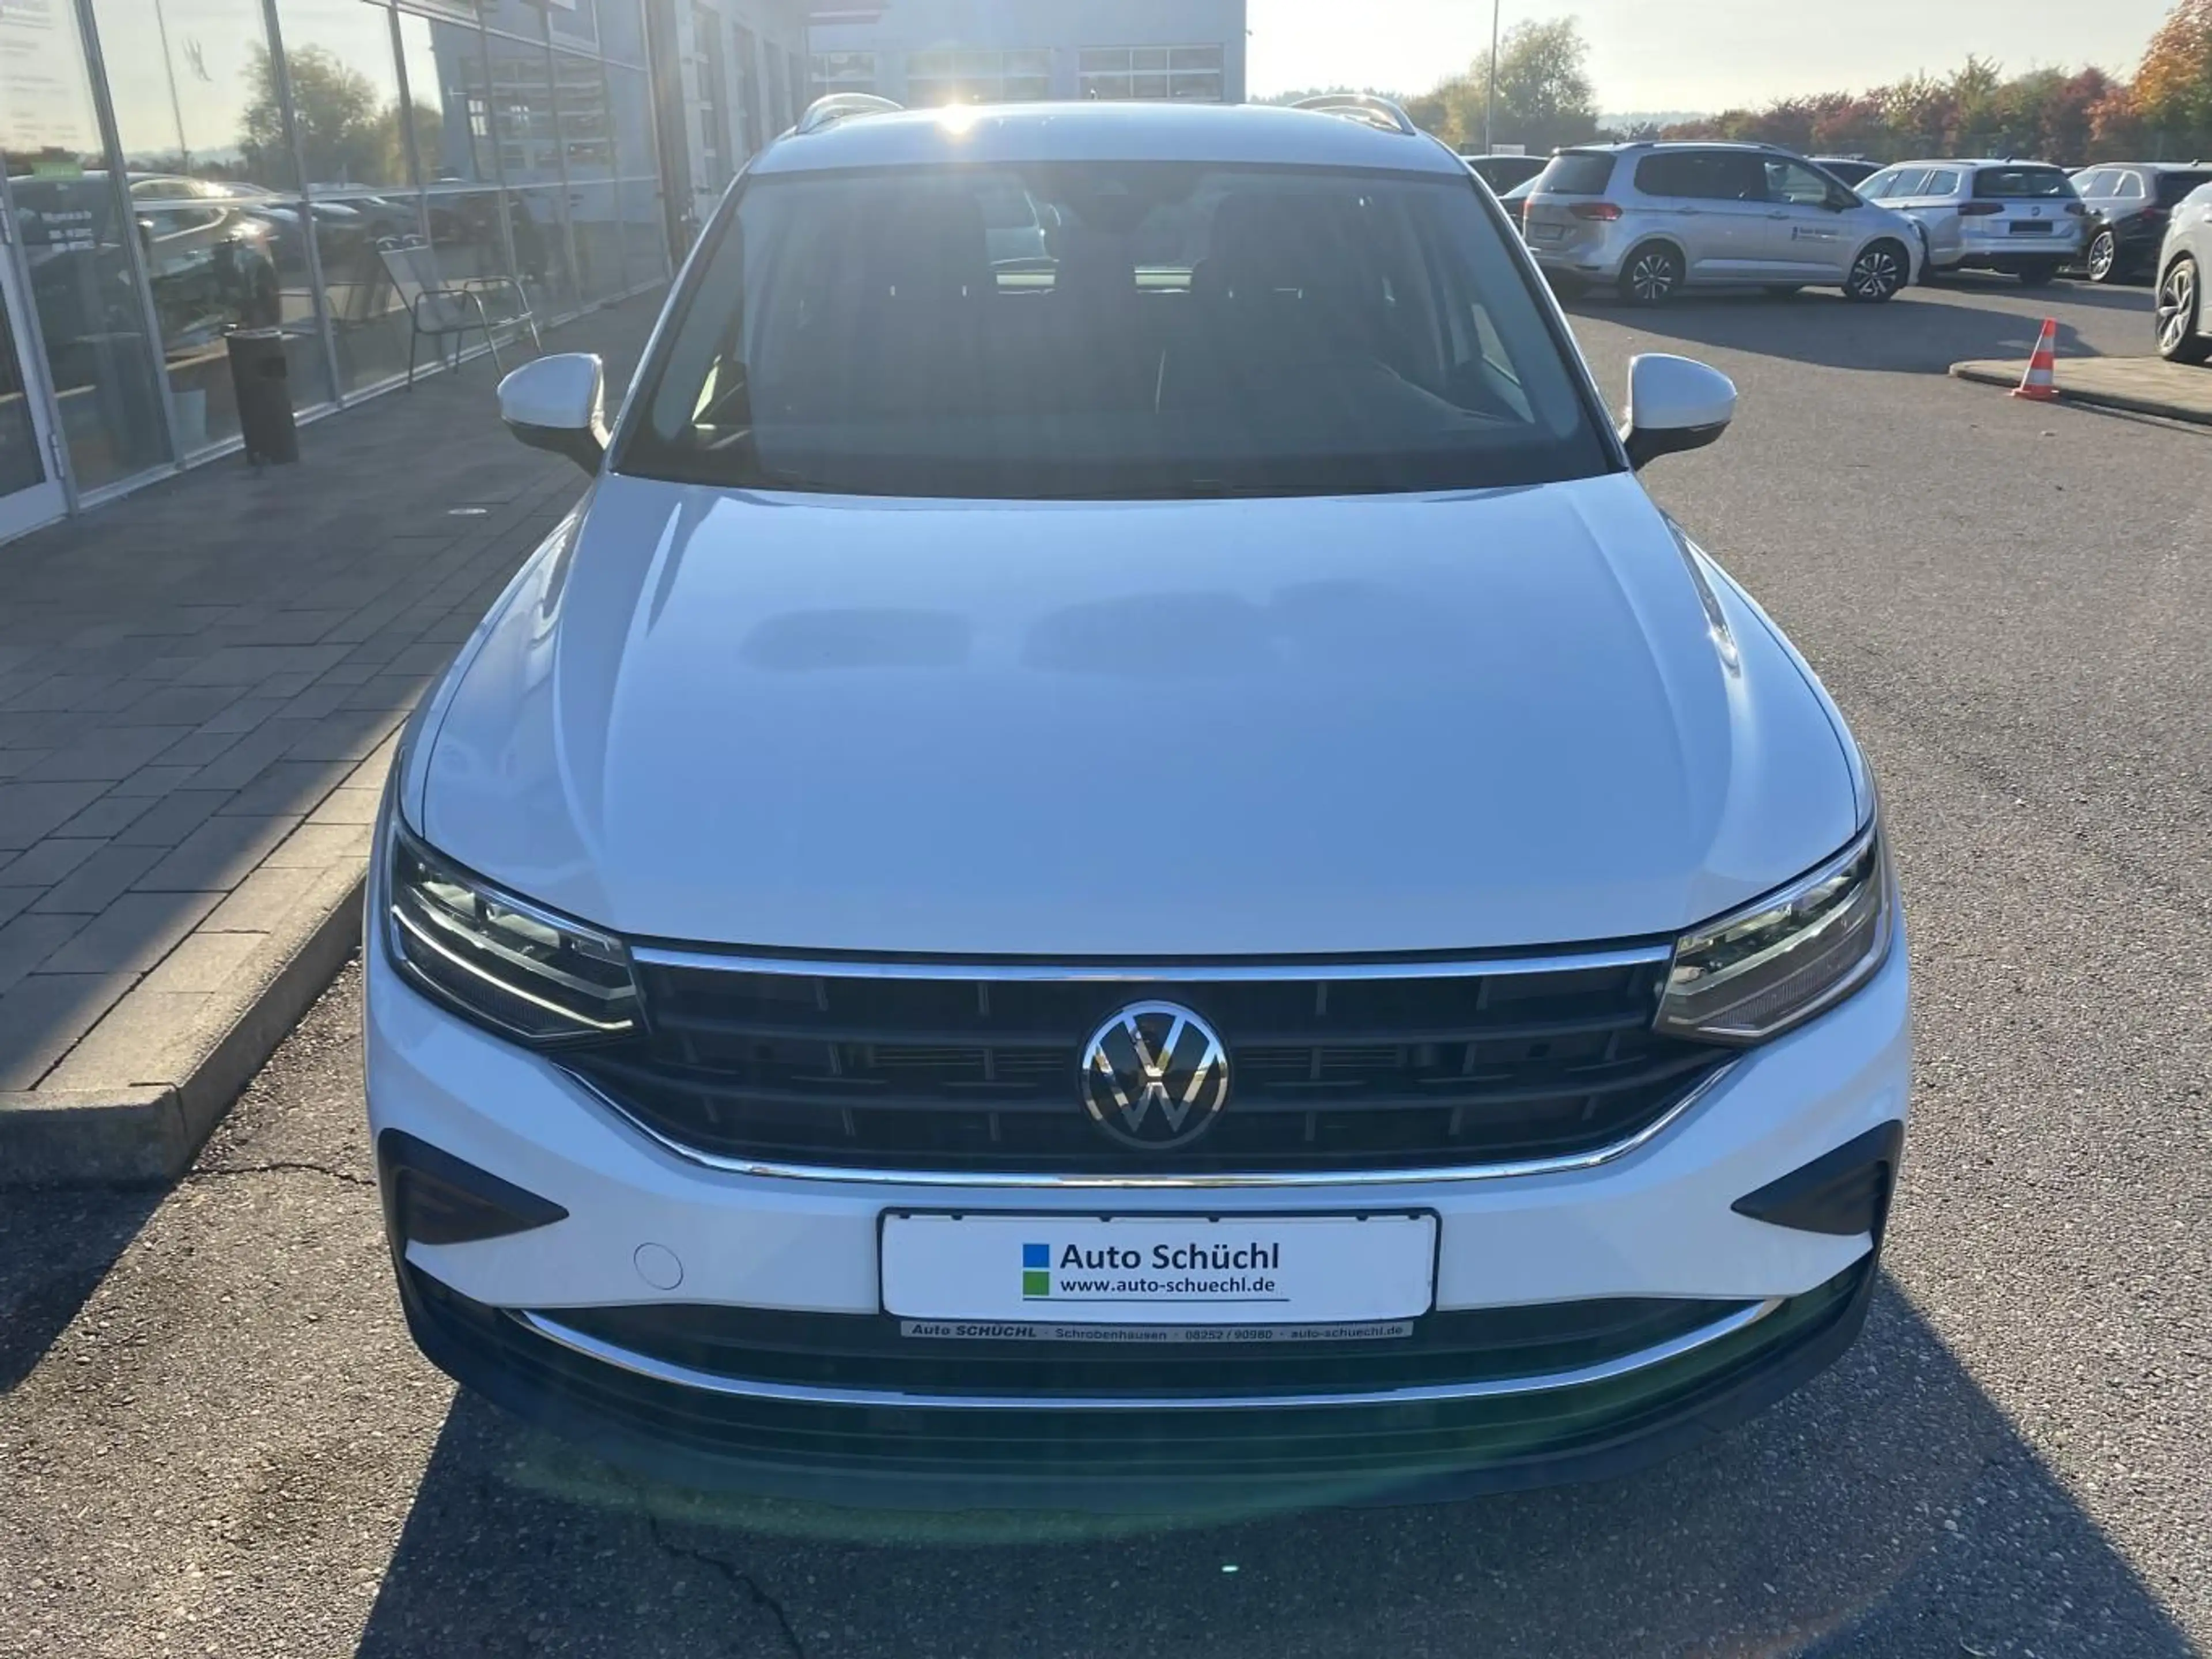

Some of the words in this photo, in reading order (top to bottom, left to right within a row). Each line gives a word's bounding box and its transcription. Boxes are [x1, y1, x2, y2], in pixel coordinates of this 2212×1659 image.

[1082, 1000, 1228, 1149] VW
[1060, 1244, 1141, 1269] Auto
[1152, 1243, 1279, 1269] Schüchl
[1060, 1277, 1276, 1293] www.auto-schuechl.de
[912, 1324, 951, 1336] Auto
[956, 1324, 1037, 1338] SCHÜCHL
[1055, 1328, 1167, 1340] Schrobenhausen
[1291, 1325, 1404, 1339] auto-schuechl.de
